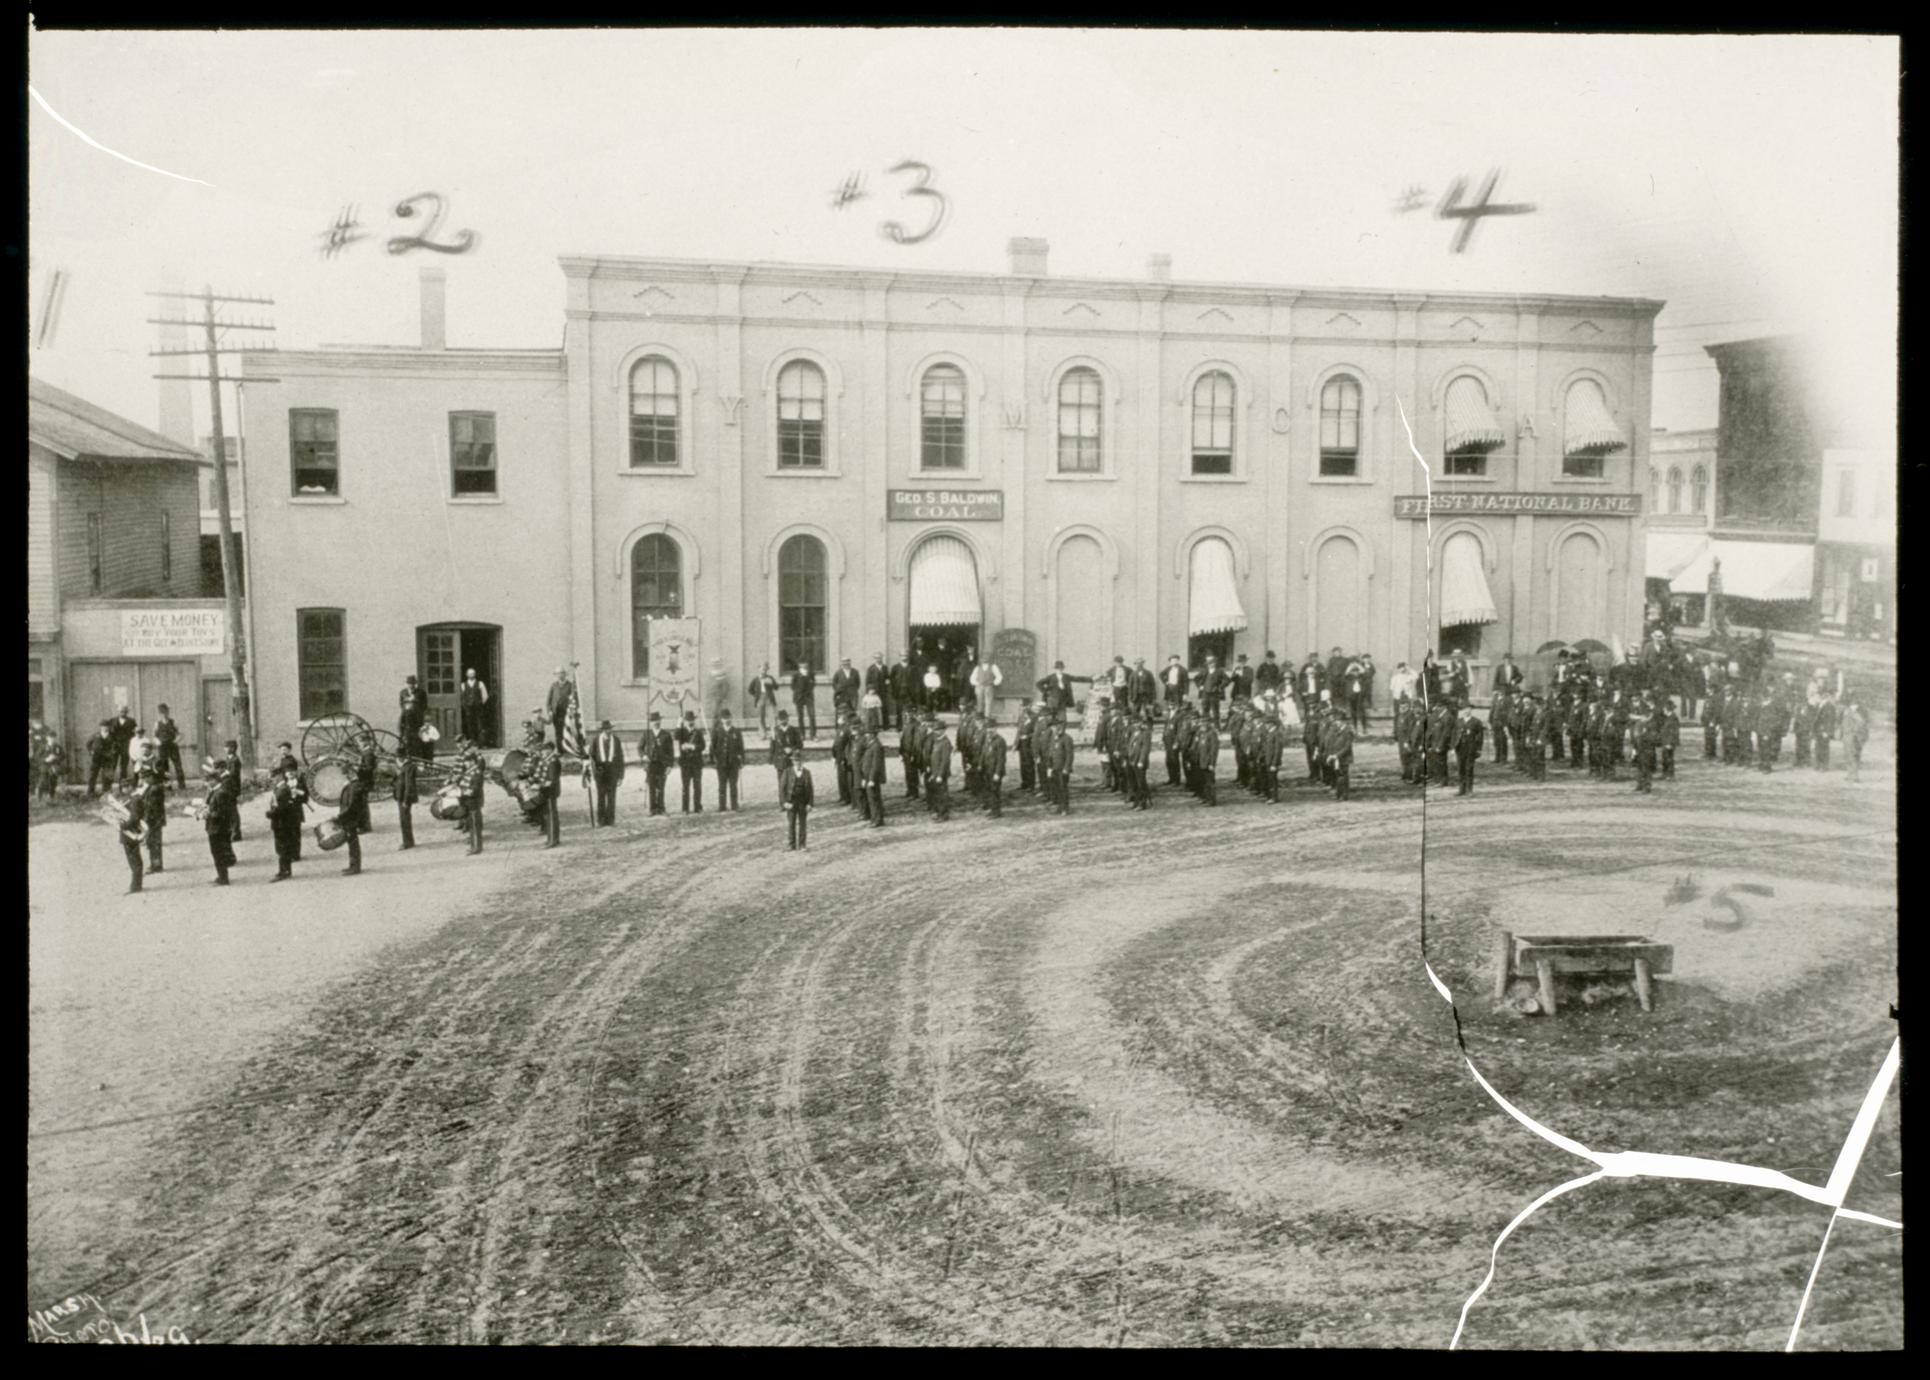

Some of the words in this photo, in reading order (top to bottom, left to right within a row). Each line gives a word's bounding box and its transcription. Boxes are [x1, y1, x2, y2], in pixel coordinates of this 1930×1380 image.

[1401, 494, 1466, 514] FIRST
[1470, 494, 1574, 511] NATIONAL
[914, 506, 977, 519] COAL
[129, 614, 168, 627] SAVE
[171, 613, 218, 626] MONEY
[997, 646, 1034, 657] COAL
